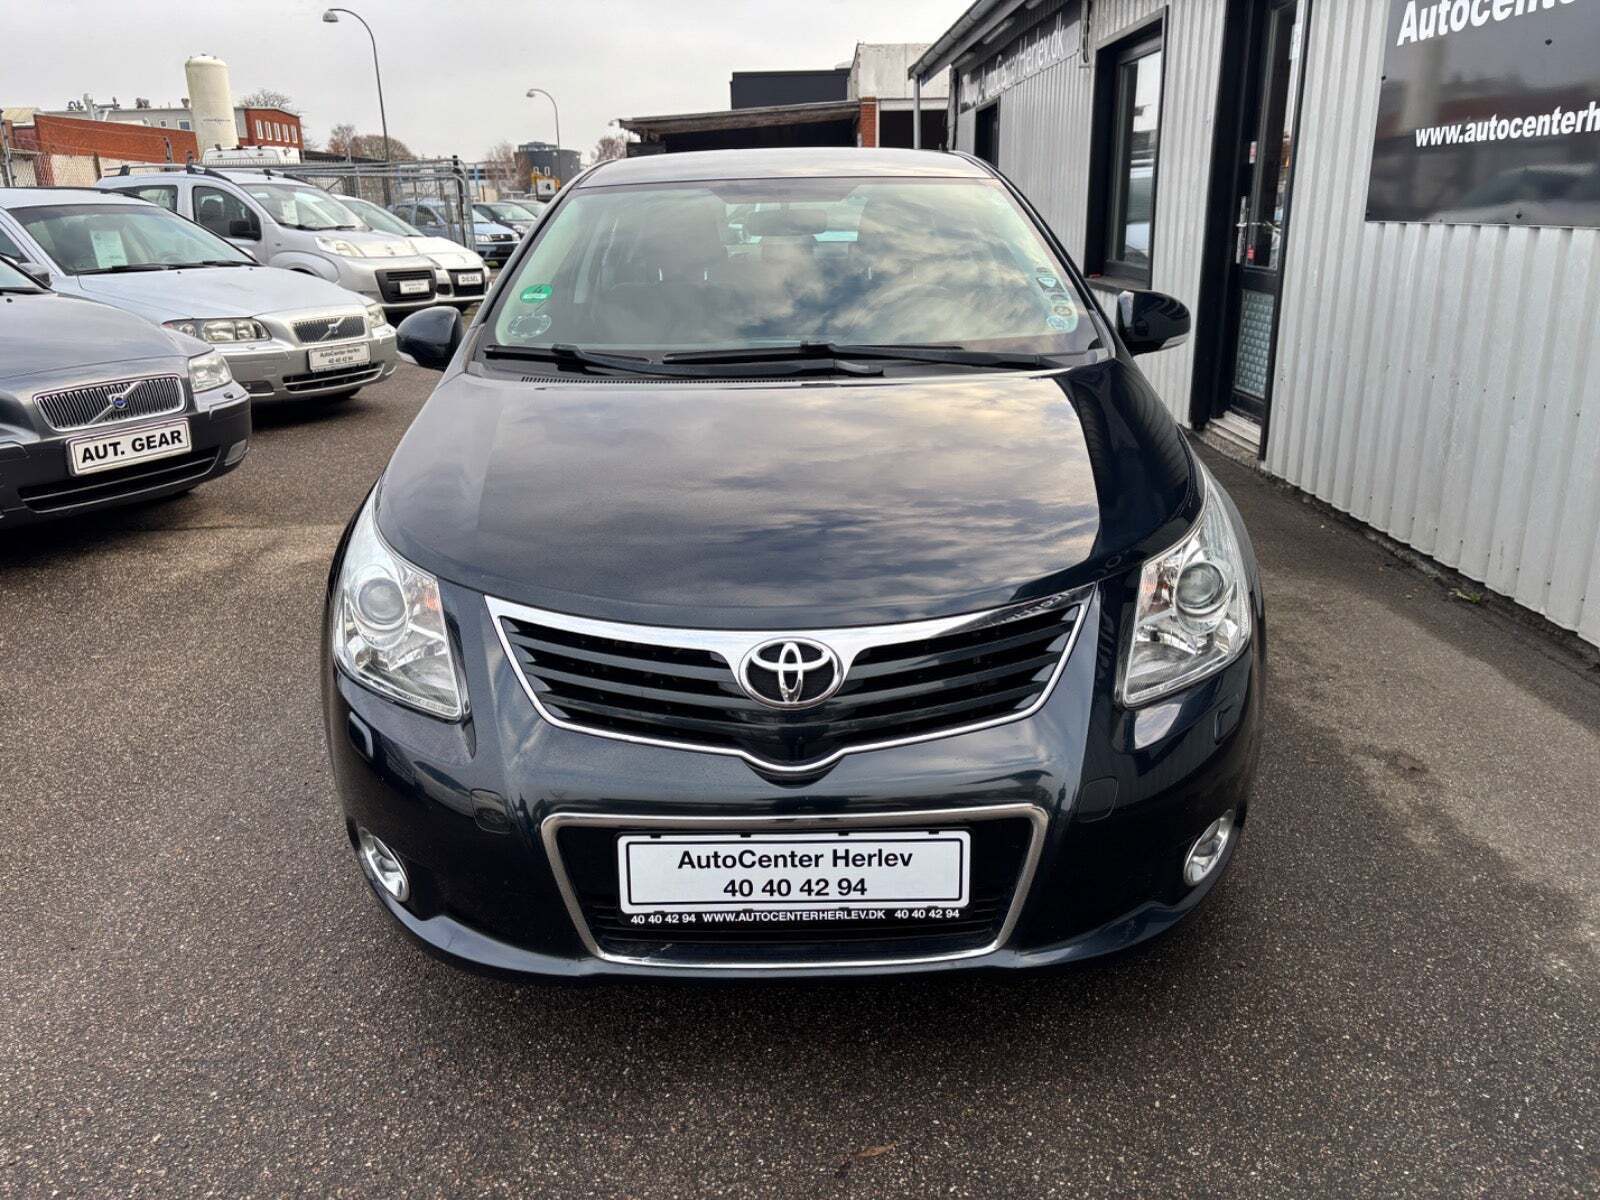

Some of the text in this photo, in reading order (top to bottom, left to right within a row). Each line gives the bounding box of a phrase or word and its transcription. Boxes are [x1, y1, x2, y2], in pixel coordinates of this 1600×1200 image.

[1397, 0, 1577, 46] Autoce
[1415, 101, 1600, 147] www.autocenterh
[82, 430, 182, 463] AUT. GEAR
[678, 848, 913, 869] AutoCenter Herlev
[723, 878, 867, 897] 40 40 42 94
[631, 909, 960, 925] 40 40 42 94 WWW.AUTOCENTERHERLEV.DK 40 40 42 94
